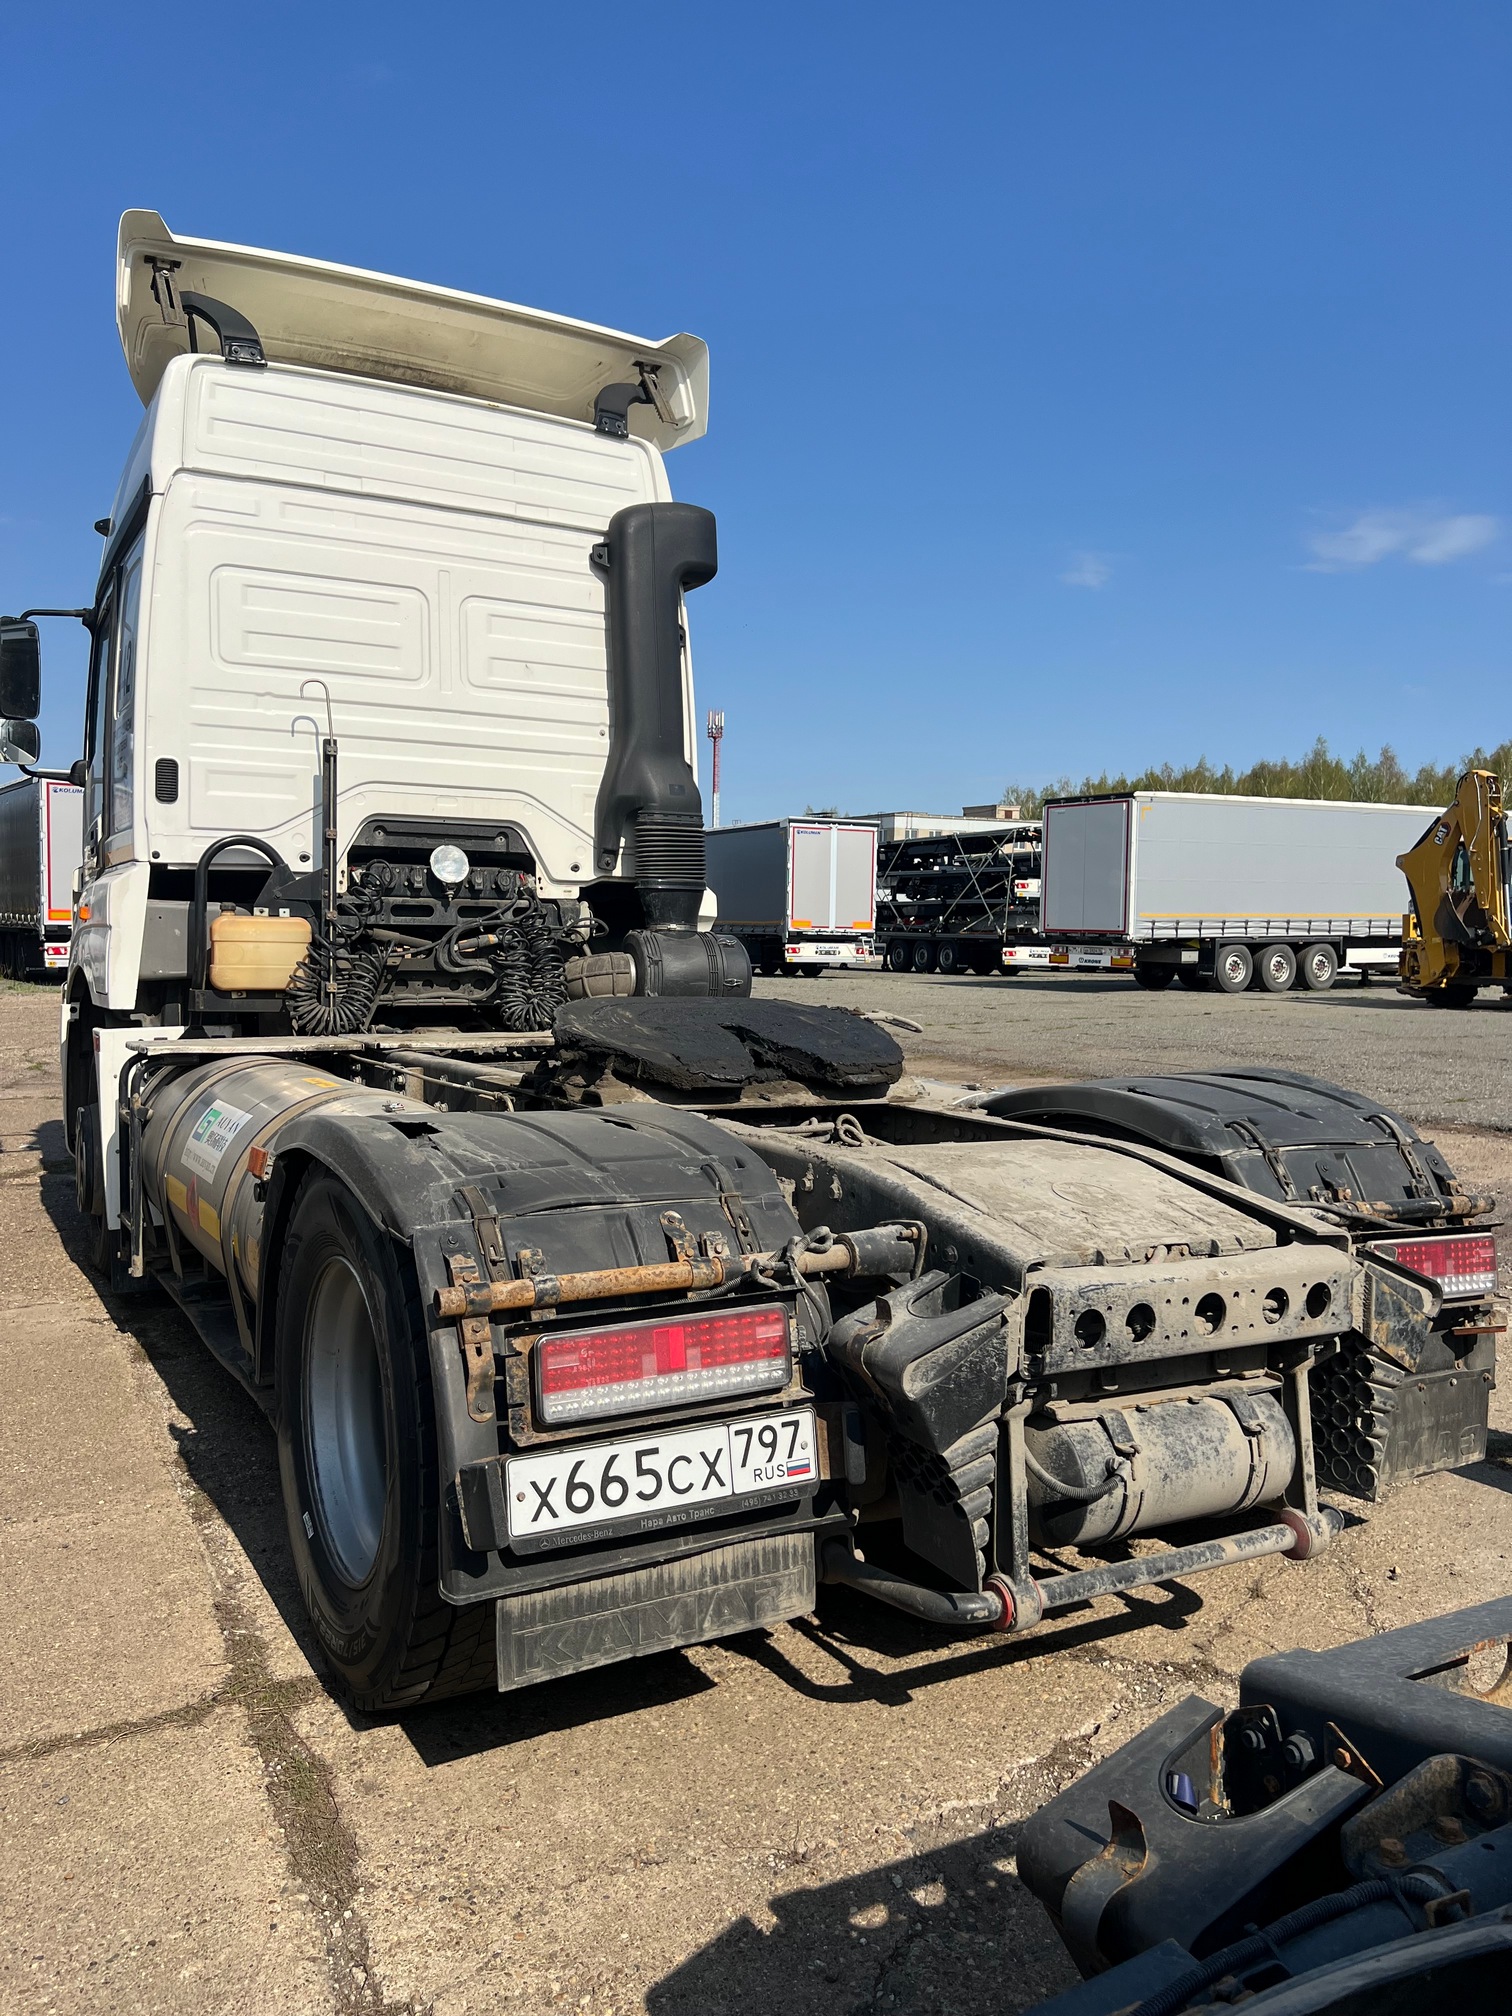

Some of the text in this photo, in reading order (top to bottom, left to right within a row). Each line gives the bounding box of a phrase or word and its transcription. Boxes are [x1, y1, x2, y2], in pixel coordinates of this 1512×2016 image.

[1433, 824, 1448, 845] CAT
[216, 1115, 240, 1134] AUYAN
[733, 1418, 801, 1470] 797
[753, 1464, 786, 1483] RUS
[741, 1495, 762, 1509] (495)
[640, 1506, 715, 1529] Нара Авто Транс
[552, 1528, 614, 1546] Mercedes-Benz
[313, 1606, 367, 1659] 315/70R22.5
